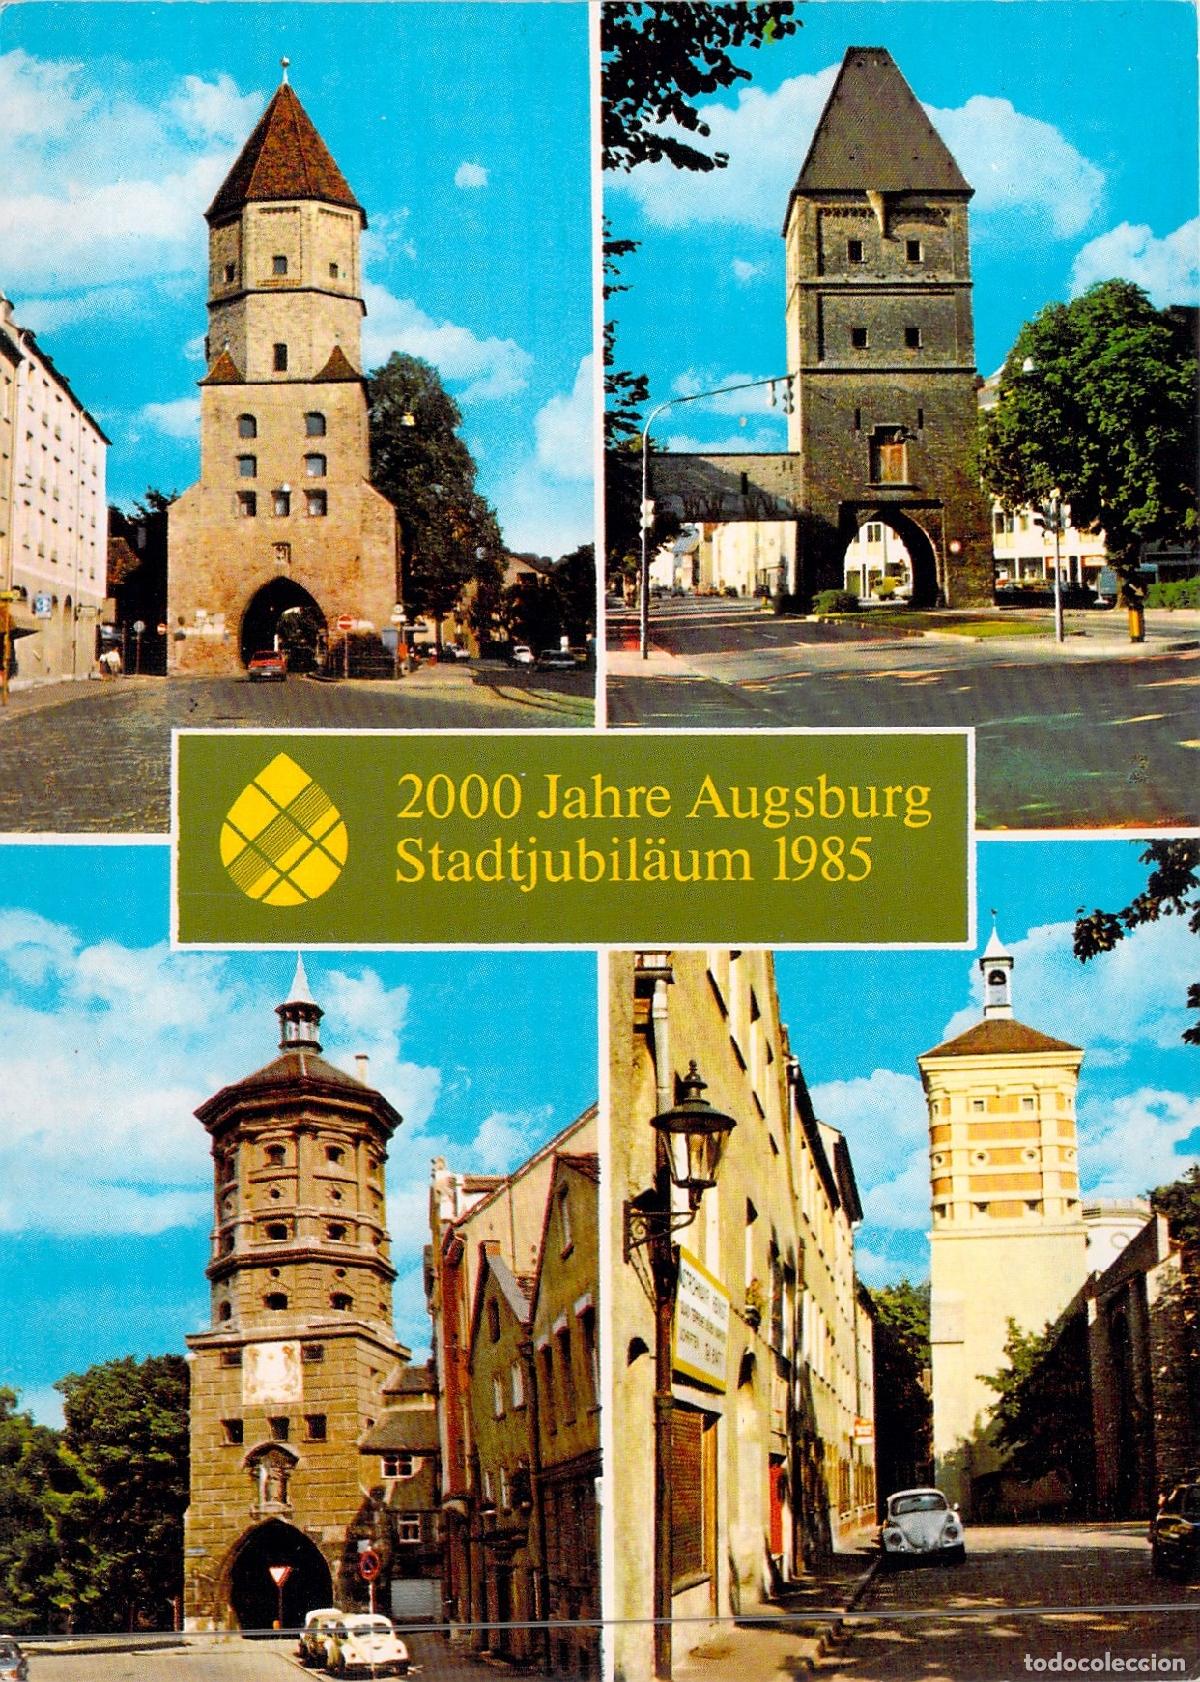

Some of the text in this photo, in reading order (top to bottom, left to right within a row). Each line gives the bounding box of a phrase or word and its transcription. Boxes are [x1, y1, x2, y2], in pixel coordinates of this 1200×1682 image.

[397, 773, 932, 829] 2000 Jahre Augsburg
[396, 836, 872, 893] Stadtjubiläum 1985
